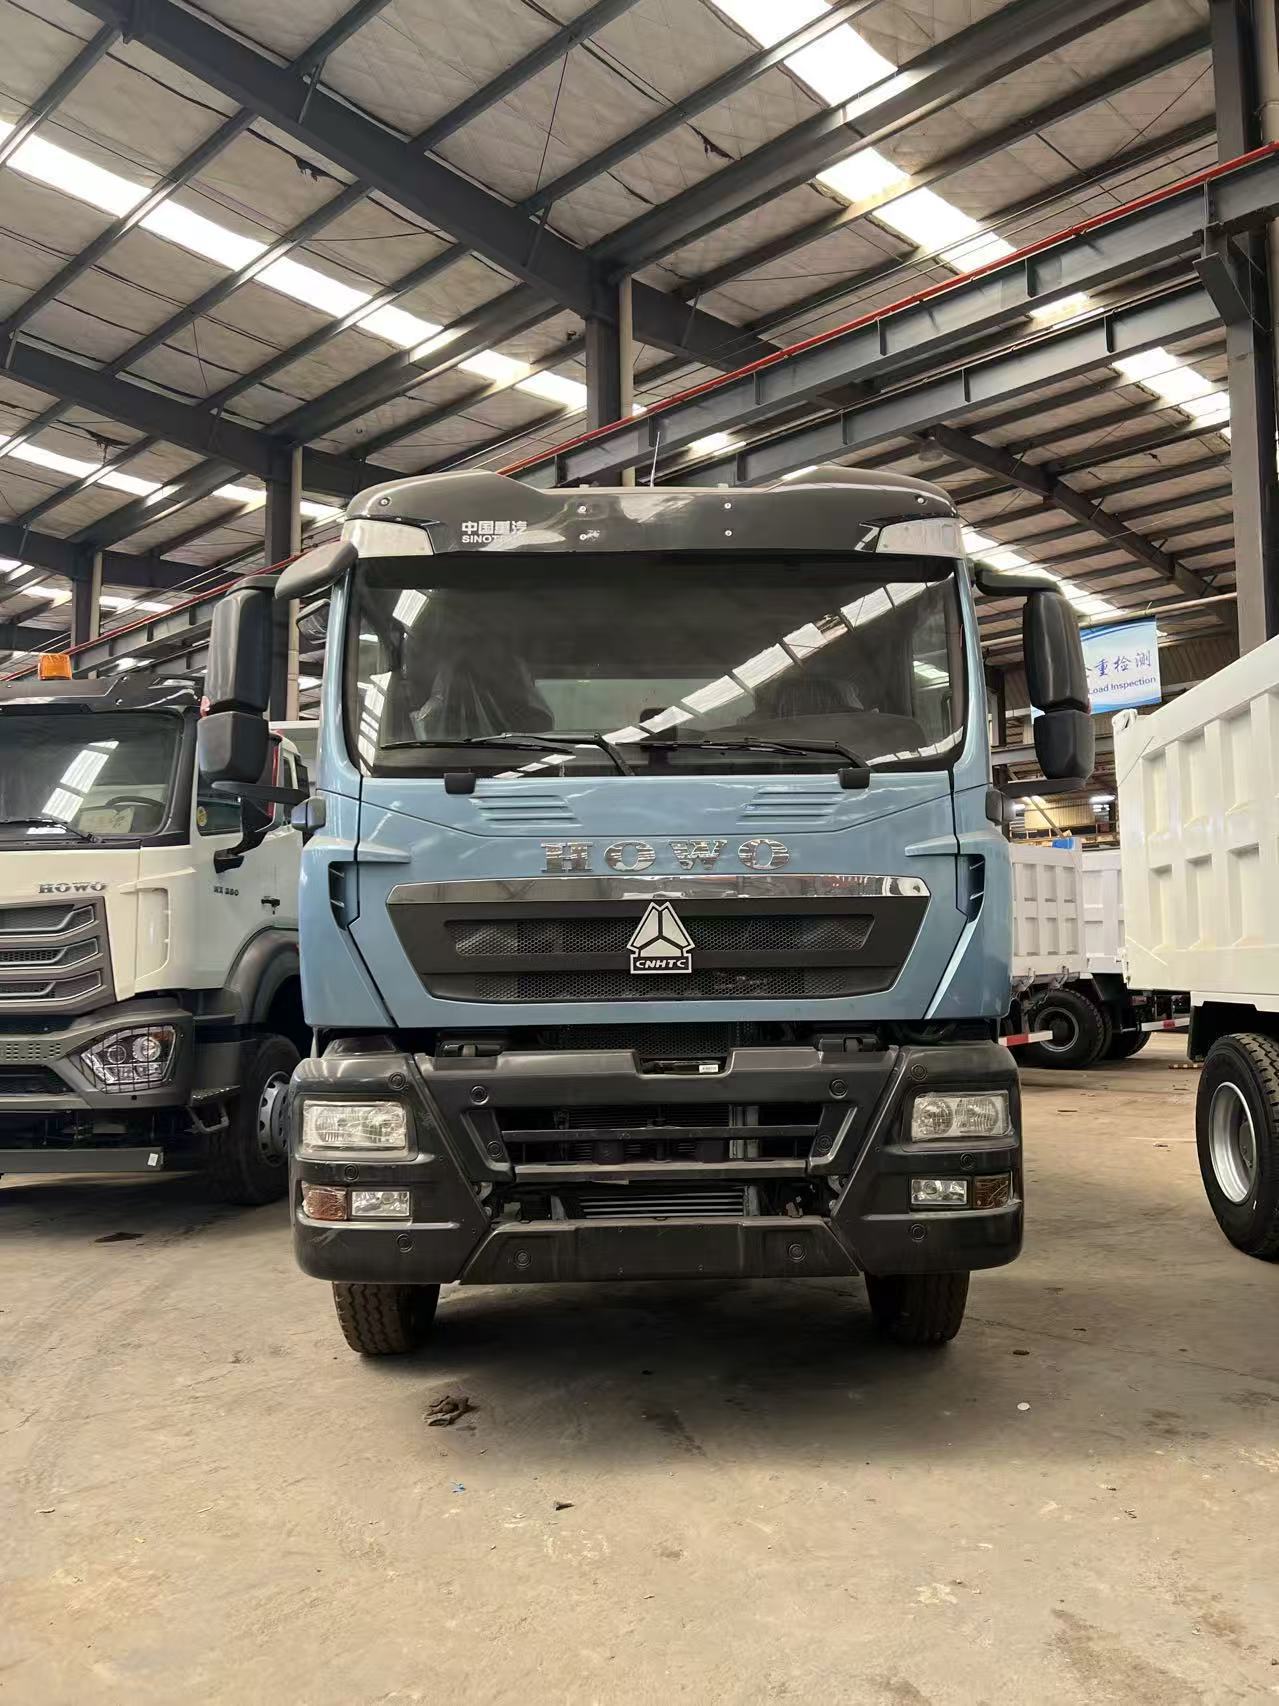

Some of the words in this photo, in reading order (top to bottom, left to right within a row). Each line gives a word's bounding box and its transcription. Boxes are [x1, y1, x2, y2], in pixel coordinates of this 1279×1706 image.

[461, 520, 528, 535] 中国重汽
[1086, 650, 1151, 677] 重检测
[1111, 677, 1157, 690] Inspection
[540, 838, 790, 873] HOWO
[38, 882, 107, 894] HOWO
[635, 959, 687, 969] CNHTC
